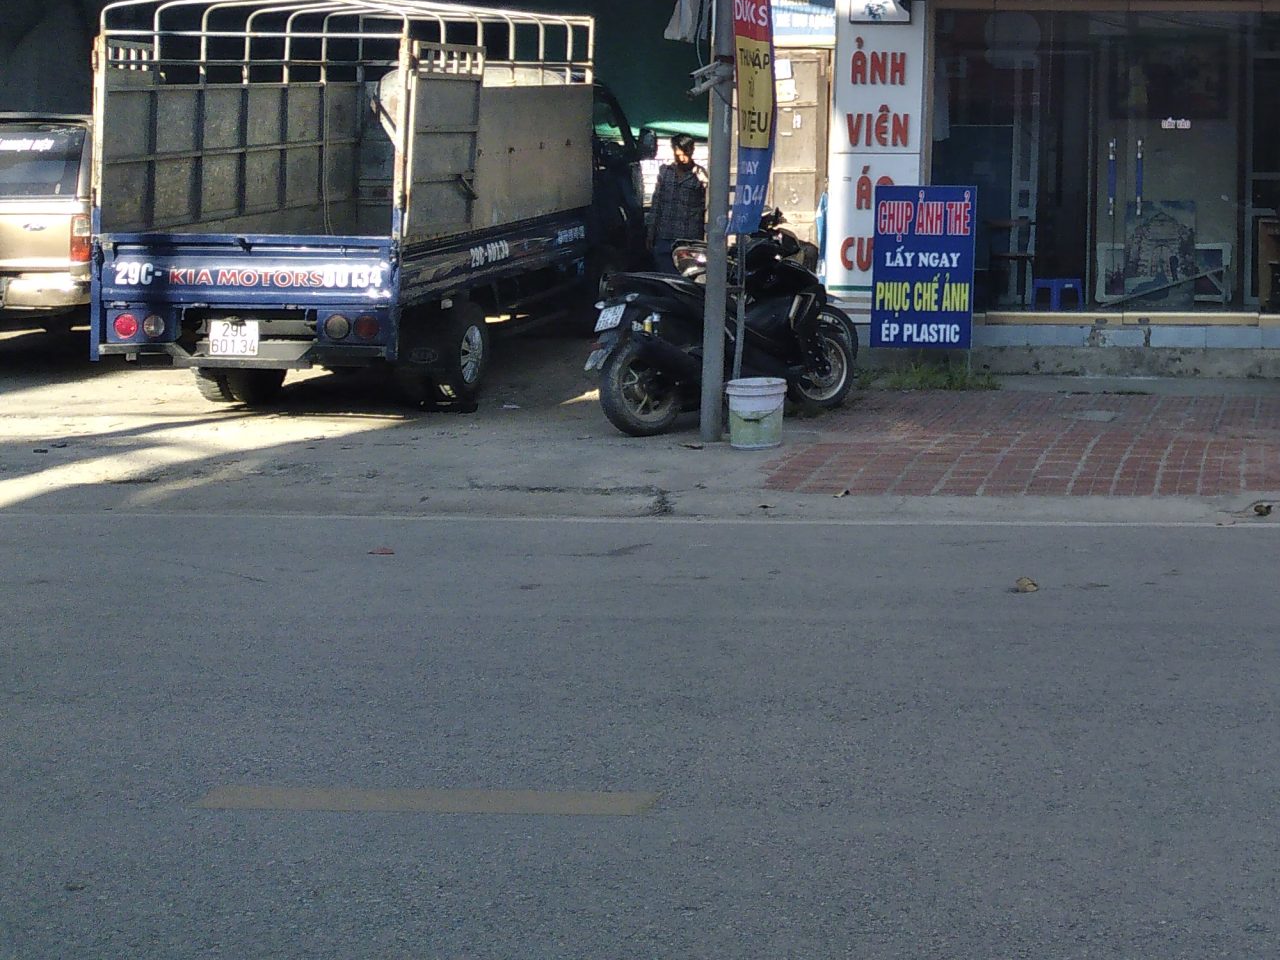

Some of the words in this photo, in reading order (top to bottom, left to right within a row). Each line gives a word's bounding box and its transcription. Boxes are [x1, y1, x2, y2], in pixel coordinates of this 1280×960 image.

[851, 37, 906, 85] ẢNH
[878, 200, 914, 243] CHỤP
[915, 191, 944, 235] ẢNH
[947, 191, 971, 235] THẺ
[885, 246, 915, 268] LẤY
[917, 252, 961, 269] NGAY
[168, 268, 212, 286] KIA
[216, 269, 323, 288] MOTORS
[876, 282, 910, 319] PHỤC
[914, 273, 940, 313] CHẾ
[942, 274, 970, 313] ẢNH
[222, 323, 248, 338] 29C
[881, 321, 900, 343] ÉP
[903, 323, 961, 344] PLASTIC
